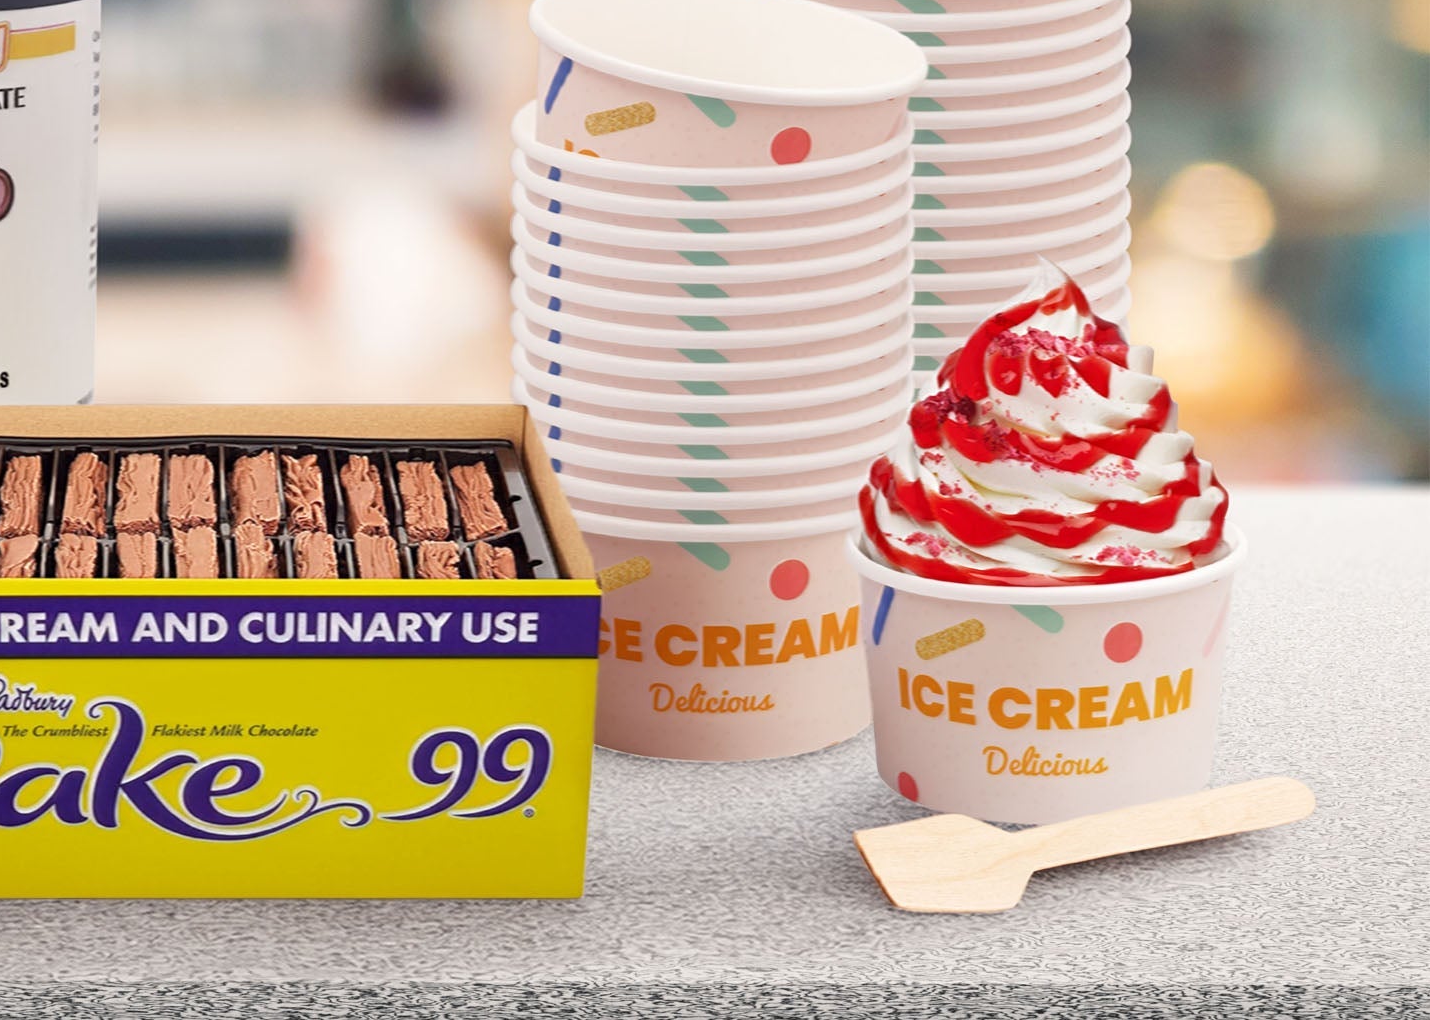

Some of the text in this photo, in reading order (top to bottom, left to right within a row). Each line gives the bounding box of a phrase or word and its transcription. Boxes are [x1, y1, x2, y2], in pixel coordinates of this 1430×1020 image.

[131, 611, 229, 644] AND
[239, 611, 452, 644] CULINARY
[461, 611, 539, 644] USE
[654, 604, 860, 668] CREAM
[649, 682, 775, 714] Delicious
[898, 667, 1194, 731] ICE CREAM
[2, 724, 318, 738] The Crumbliest Flakiest Milk Chocolate
[377, 728, 552, 822] 99
[982, 745, 1109, 777] Delicious
